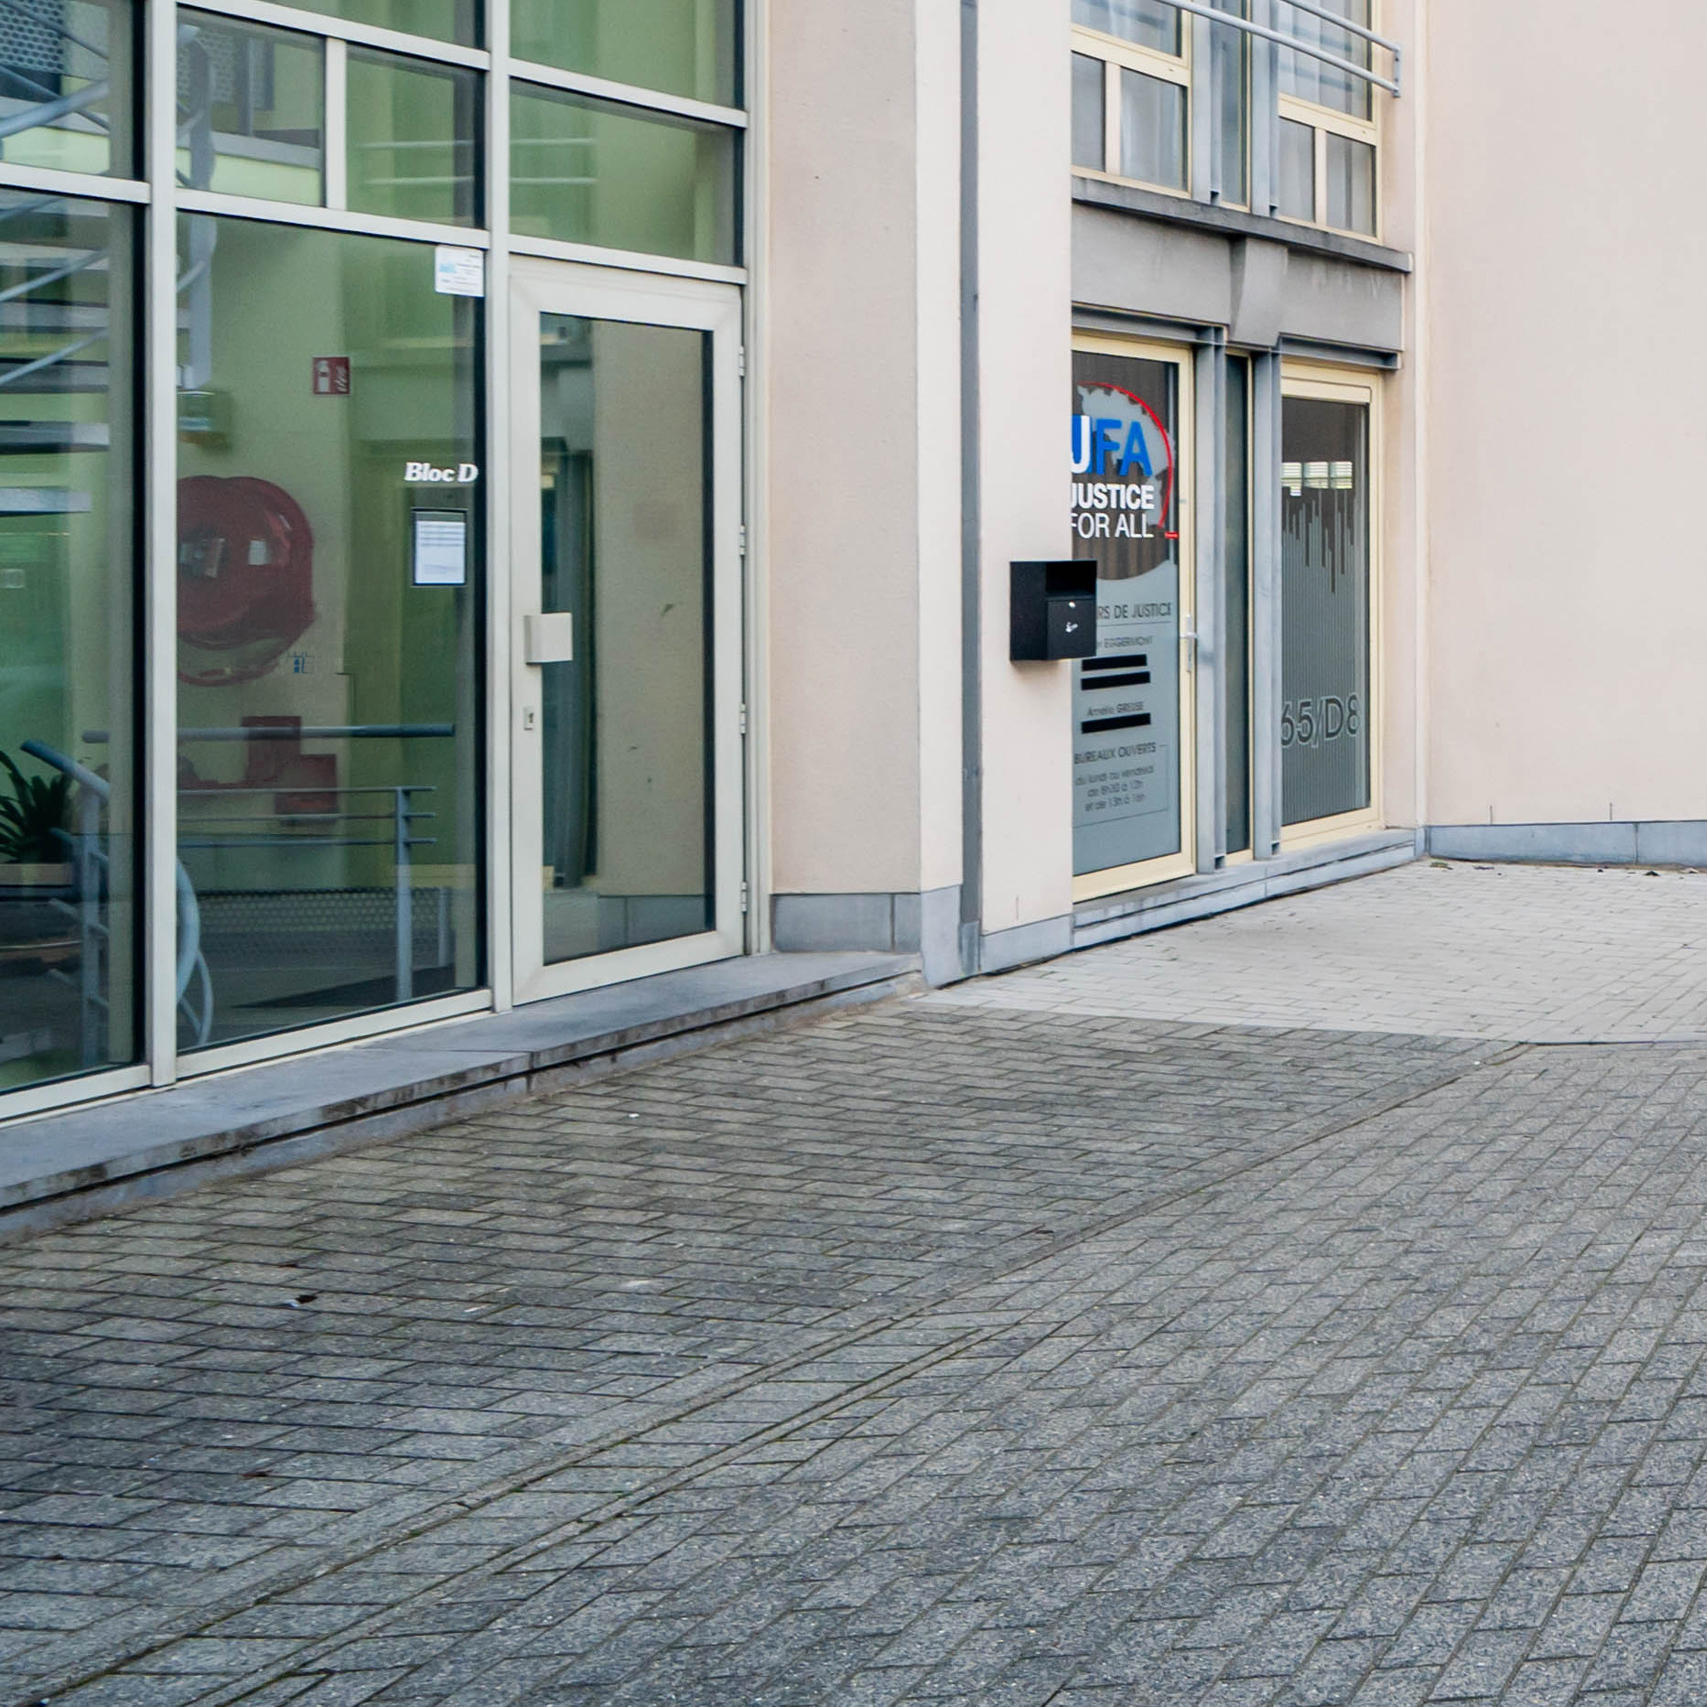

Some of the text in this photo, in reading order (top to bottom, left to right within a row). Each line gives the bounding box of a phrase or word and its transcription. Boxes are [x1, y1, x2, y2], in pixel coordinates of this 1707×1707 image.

[404, 462, 479, 483] Bloc D
[1071, 482, 1155, 511] JUSTICE
[1114, 513, 1155, 539] ALL
[1114, 604, 1128, 619] DE
